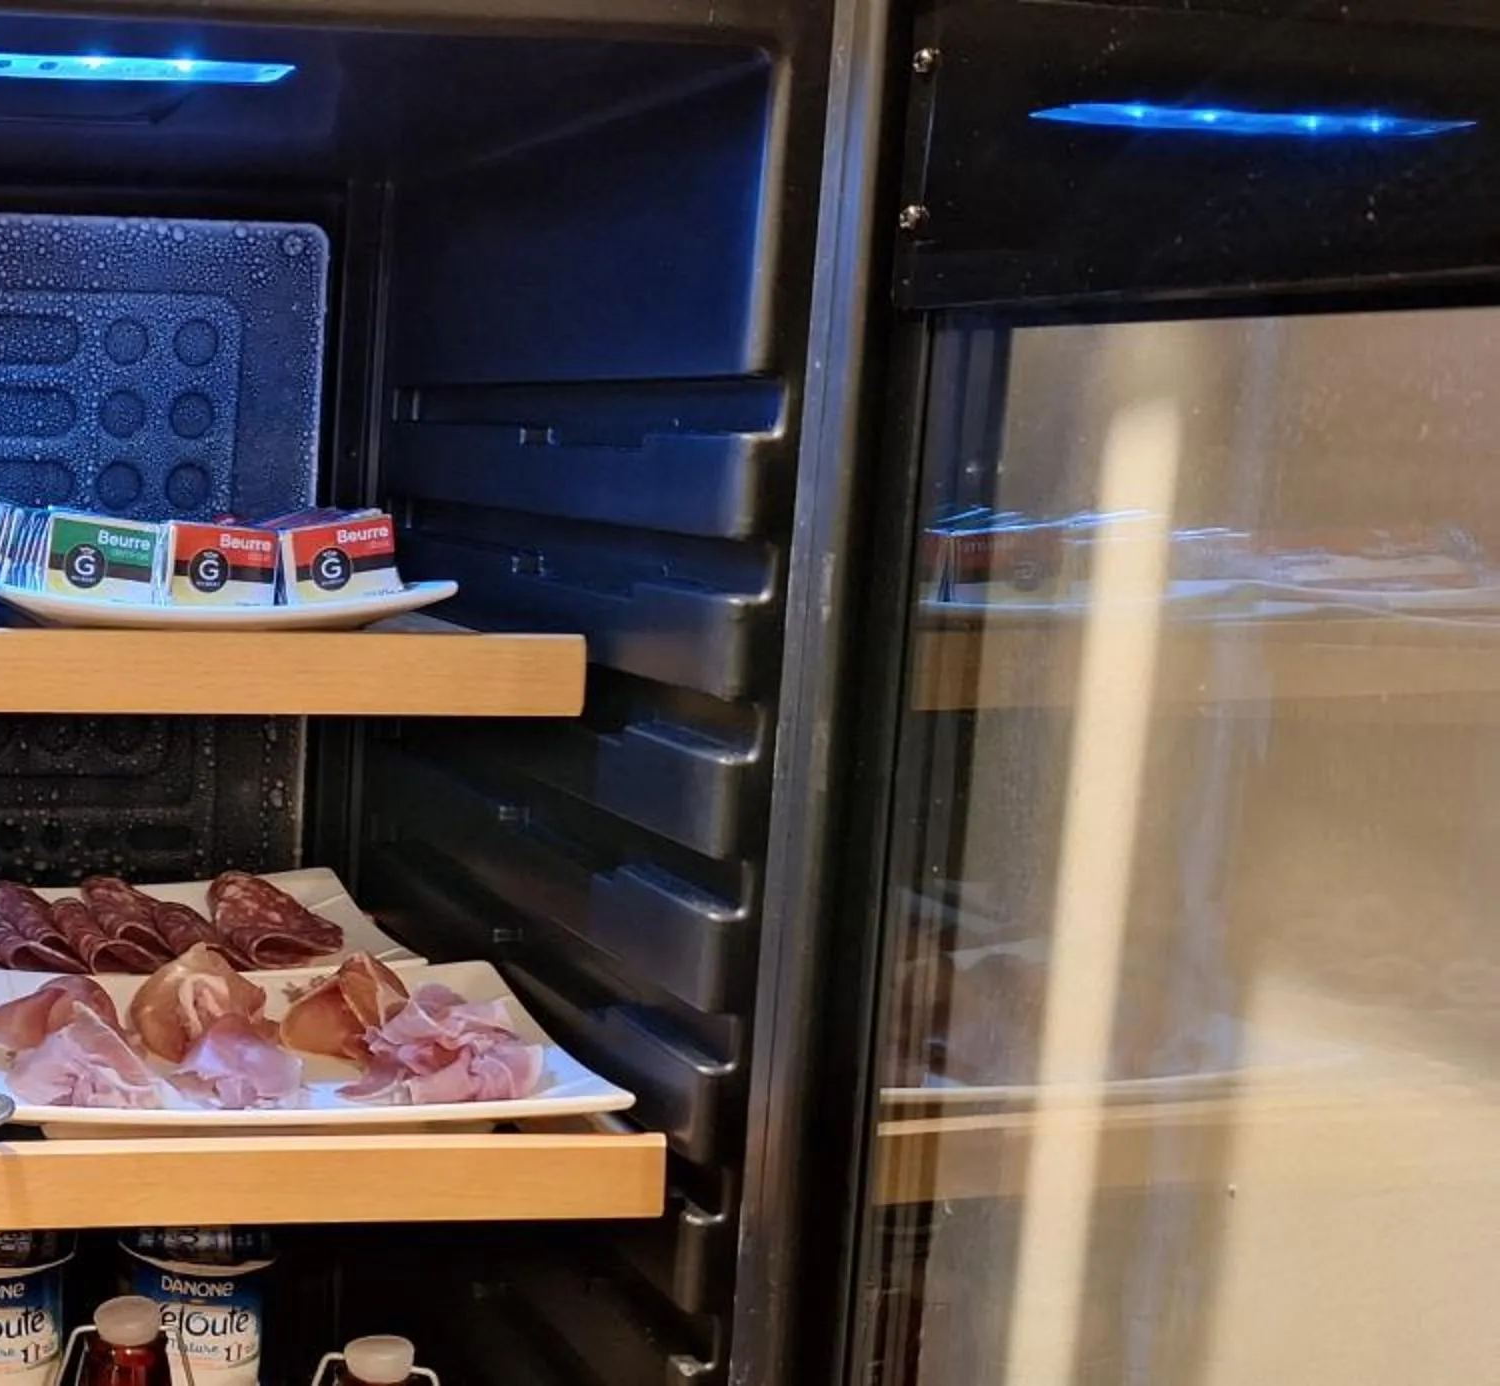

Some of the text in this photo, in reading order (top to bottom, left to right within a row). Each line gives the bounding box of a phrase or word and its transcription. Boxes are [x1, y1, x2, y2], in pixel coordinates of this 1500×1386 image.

[97, 529, 150, 551] Beurre
[219, 533, 271, 552] Beurre
[336, 526, 388, 545] Beurre
[74, 555, 96, 576] G
[198, 560, 220, 581] G
[321, 557, 342, 579] G
[160, 1275, 235, 1297] DANONE
[160, 1304, 249, 1337] elouté
